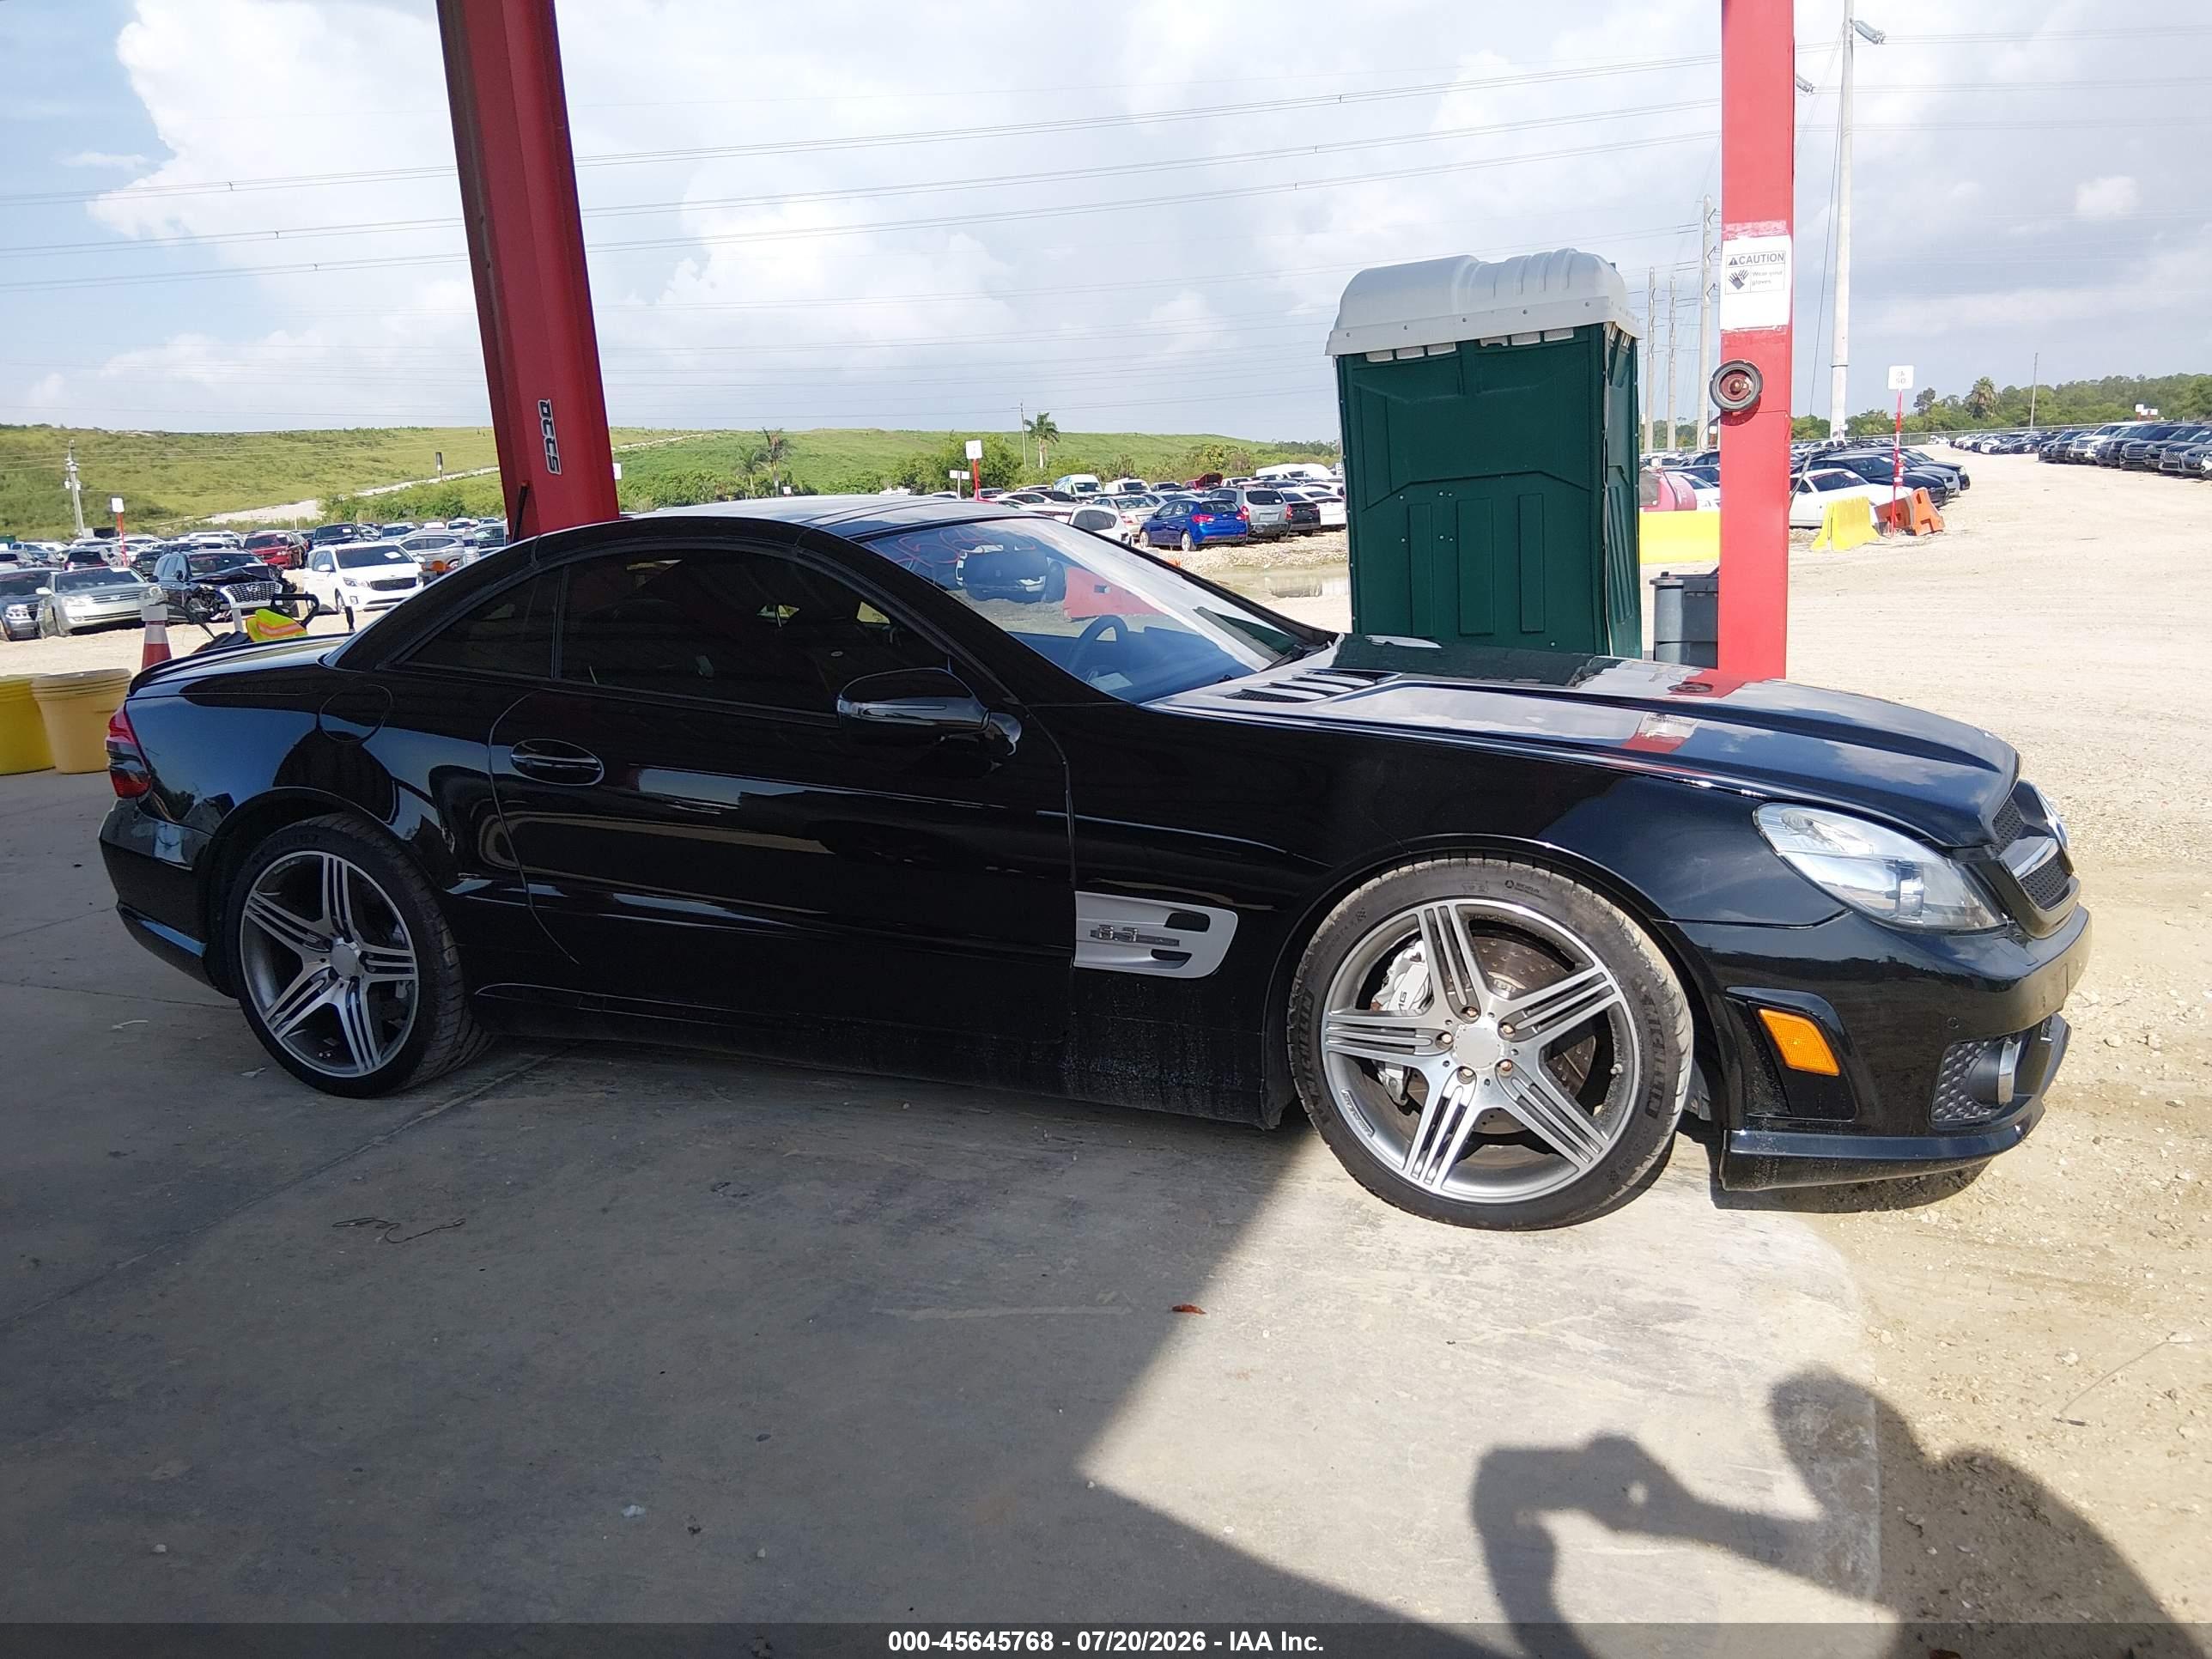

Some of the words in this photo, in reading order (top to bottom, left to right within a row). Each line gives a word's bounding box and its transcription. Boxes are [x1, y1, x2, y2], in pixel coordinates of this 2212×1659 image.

[1739, 253, 1784, 264] CAUTION
[1297, 989, 1319, 1099] MICHELIN
[1648, 1003, 1667, 1116] MICHELIN
